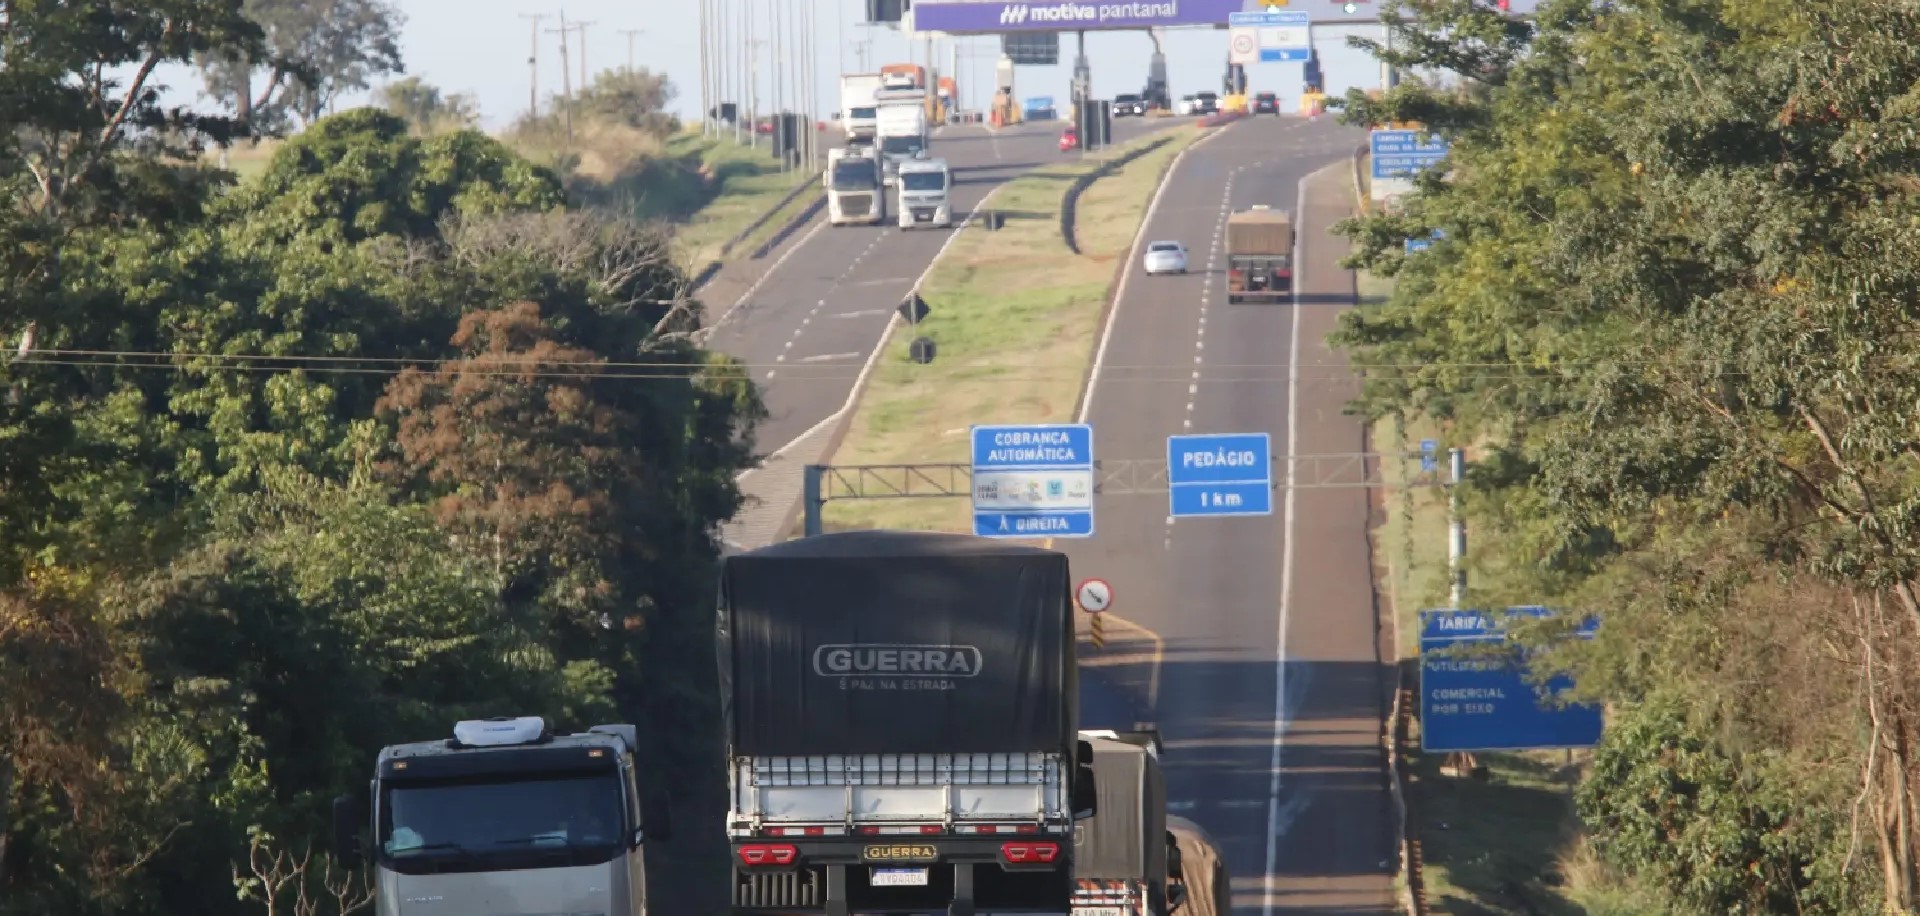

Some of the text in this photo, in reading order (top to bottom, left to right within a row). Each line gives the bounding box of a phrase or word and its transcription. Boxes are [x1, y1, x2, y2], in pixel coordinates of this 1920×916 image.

[1031, 1, 1176, 21] motiva pantanal
[995, 432, 1069, 446] COBRANÇA
[988, 445, 1075, 461] AUTOMÁTICA
[1183, 447, 1254, 467] PEDÁGIO
[1201, 492, 1208, 507] 1
[1016, 517, 1069, 531] DIREITA
[1438, 616, 1486, 630] TARIFA
[827, 650, 969, 672] GUERRA
[881, 680, 896, 690] NA
[904, 680, 956, 690] ESTRADA
[1432, 688, 1505, 700] COMERCIAL
[870, 847, 931, 858] GUERRA
